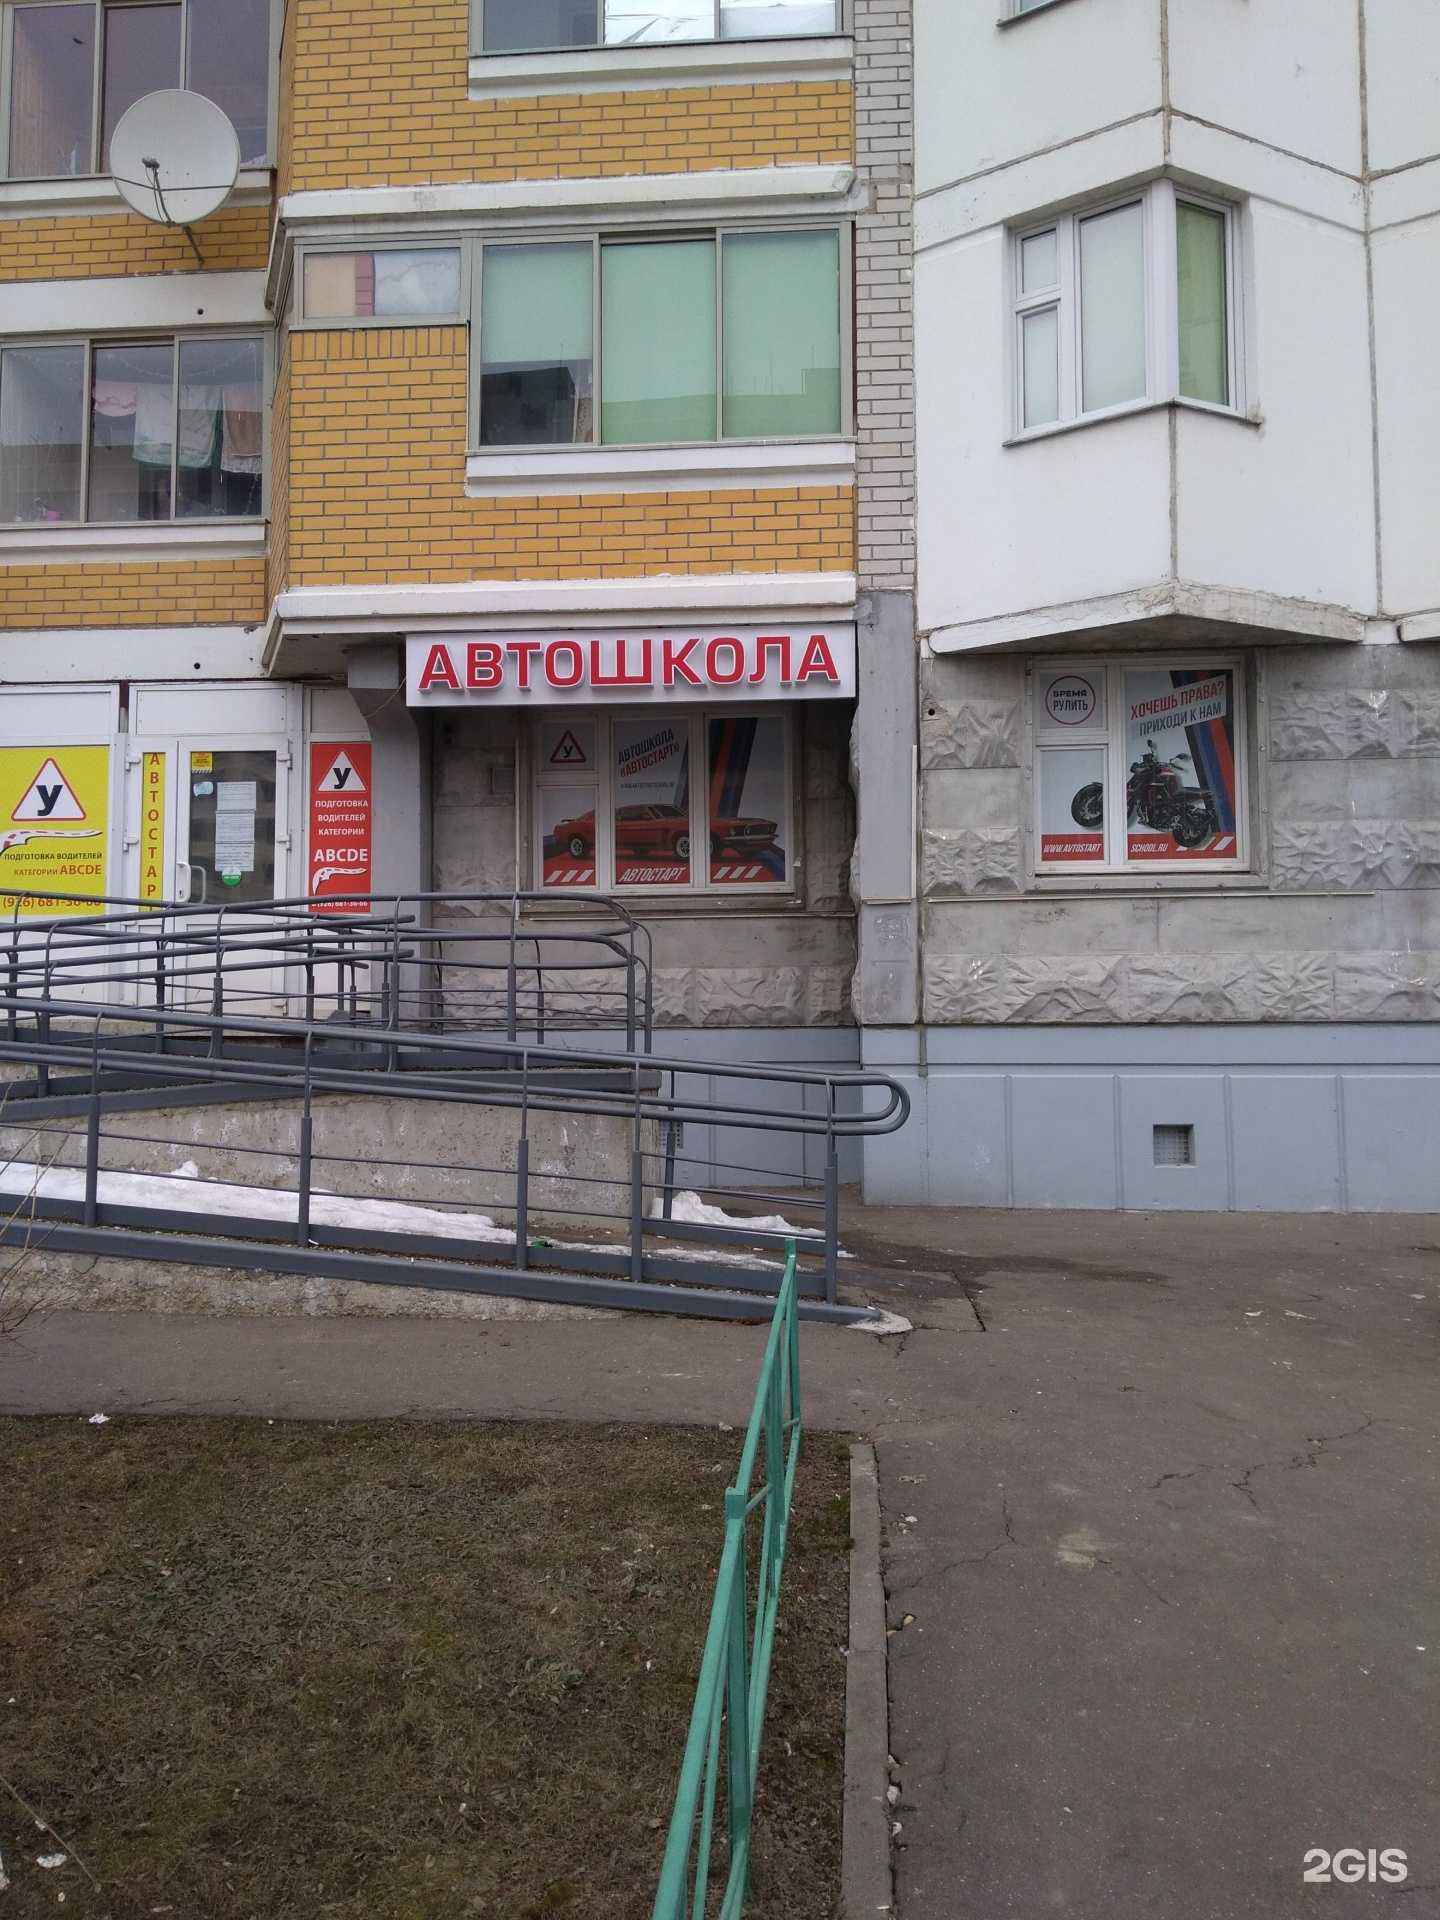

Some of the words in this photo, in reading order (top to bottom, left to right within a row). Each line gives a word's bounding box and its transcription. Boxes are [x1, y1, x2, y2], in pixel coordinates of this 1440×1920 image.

[418, 634, 840, 690] АВТОШКОЛА
[1053, 690, 1087, 698] ВРЕМЯ
[1053, 700, 1088, 711] РУЛИТЬ
[1131, 694, 1178, 720] ХОЧЕШЬ
[1180, 682, 1225, 707] ПРАВА?
[1139, 714, 1188, 737] ПРИХОДИ
[1190, 710, 1198, 722] К
[1199, 701, 1222, 719] НАМ
[618, 728, 674, 765] АВТОШКОЛА
[315, 800, 368, 808] ПОДГОТОВКА
[318, 812, 365, 822] ВОДИТЕЛЕЙ
[147, 752, 160, 911] АВТОСТАР
[318, 828, 364, 836] КАТЕГОРИИ
[1130, 843, 1168, 852] SCHOOL.RU
[4, 852, 55, 861] ПОДГОТОВКА
[56, 851, 102, 860] ВОДИТЕЛЕЙ
[14, 868, 57, 876] КАТЕГОРИИ
[618, 867, 686, 882] АВТОСТАРТ
[3, 896, 34, 908] (96)
